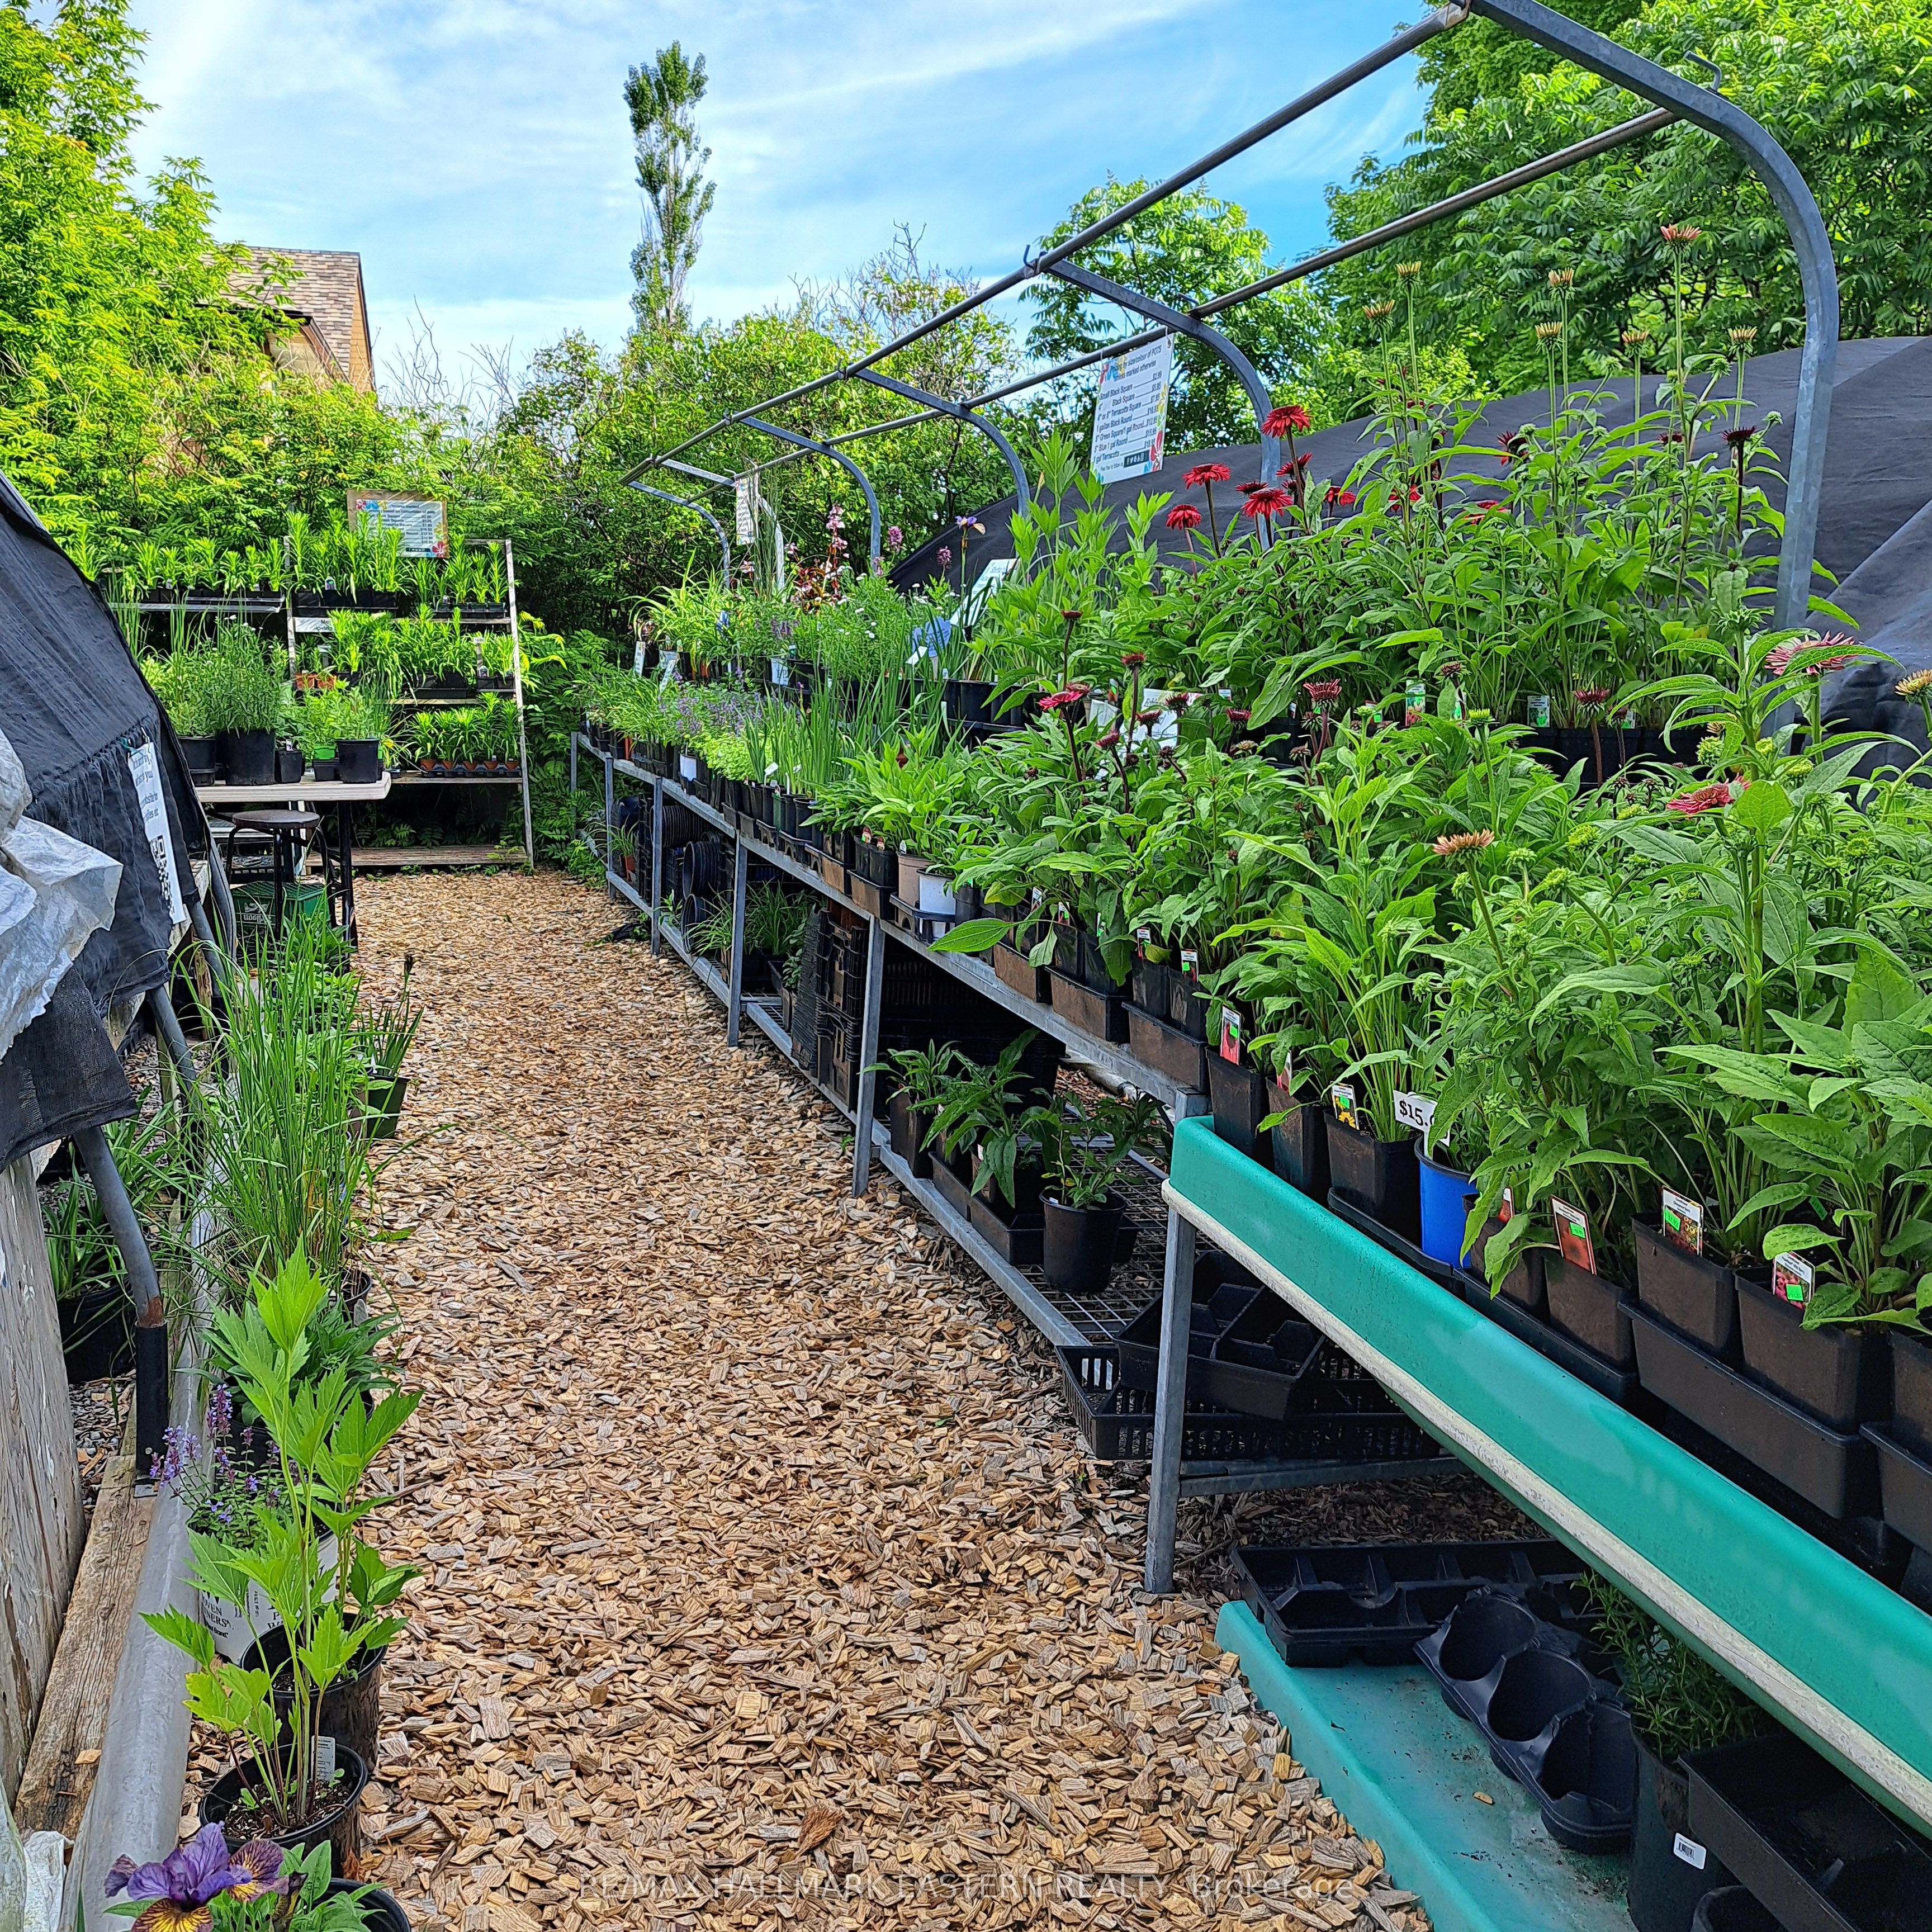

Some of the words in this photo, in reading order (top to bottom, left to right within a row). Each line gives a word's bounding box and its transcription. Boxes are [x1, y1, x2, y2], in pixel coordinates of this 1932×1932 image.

[1151, 345, 1162, 357] POTS
[1126, 366, 1139, 376] marked
[1139, 359, 1156, 372] otherwise
[1100, 390, 1110, 400] Small
[1110, 387, 1120, 396] Black
[1120, 382, 1133, 394] Square
[1152, 370, 1162, 381] $2.99
[1112, 396, 1121, 406] Black
[1123, 392, 1135, 404] Square
[1152, 382, 1161, 392] $5.95
[1111, 405, 1129, 416] Terracotta
[1129, 401, 1141, 413] Square
[1150, 393, 1159, 403] $7.95
[1099, 422, 1110, 433] gallon
[1110, 418, 1120, 428] Black
[1120, 414, 1132, 424] Round
[1100, 432, 1110, 441] Green
[1116, 435, 1128, 446] Round
[1102, 449, 1119, 460] Terracotta
